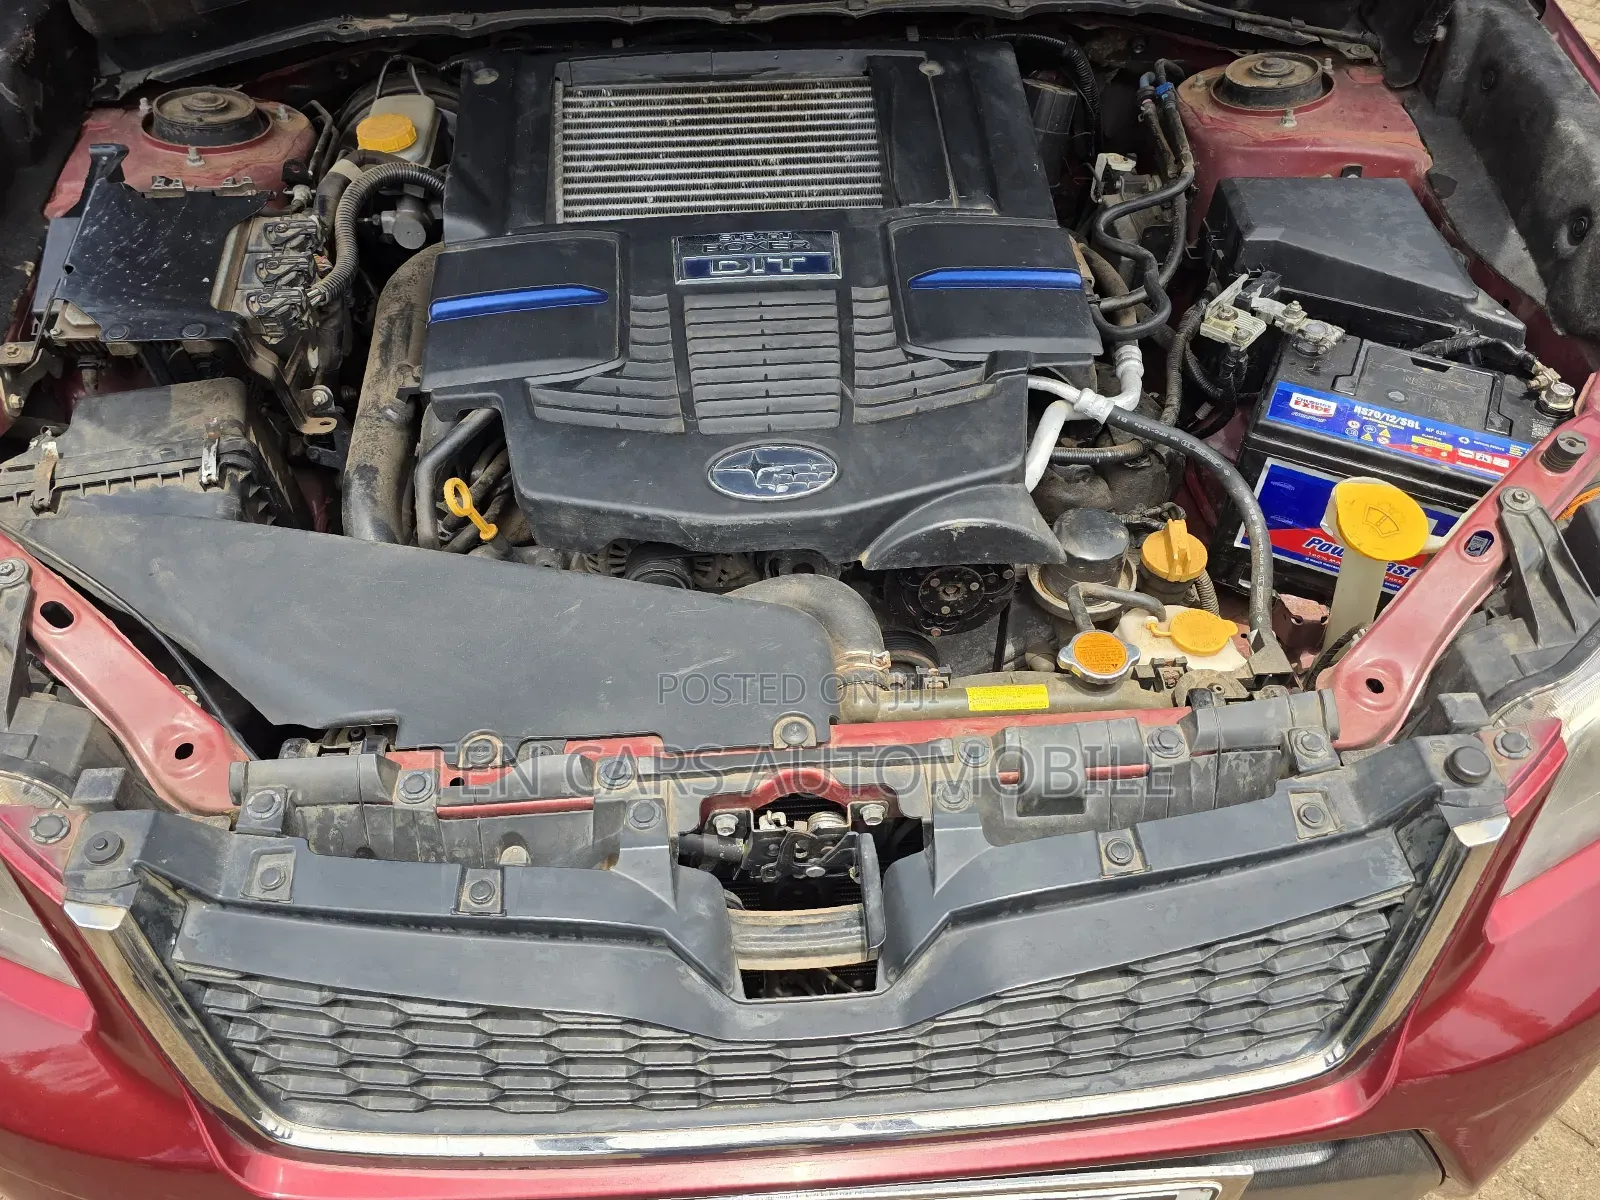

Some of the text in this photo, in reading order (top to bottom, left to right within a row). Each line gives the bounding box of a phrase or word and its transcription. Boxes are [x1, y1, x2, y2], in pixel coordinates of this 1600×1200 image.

[719, 232, 792, 241] SUBARU
[702, 240, 811, 253] BOXER
[710, 256, 806, 275] DIT
[1294, 399, 1331, 414] EXIDE
